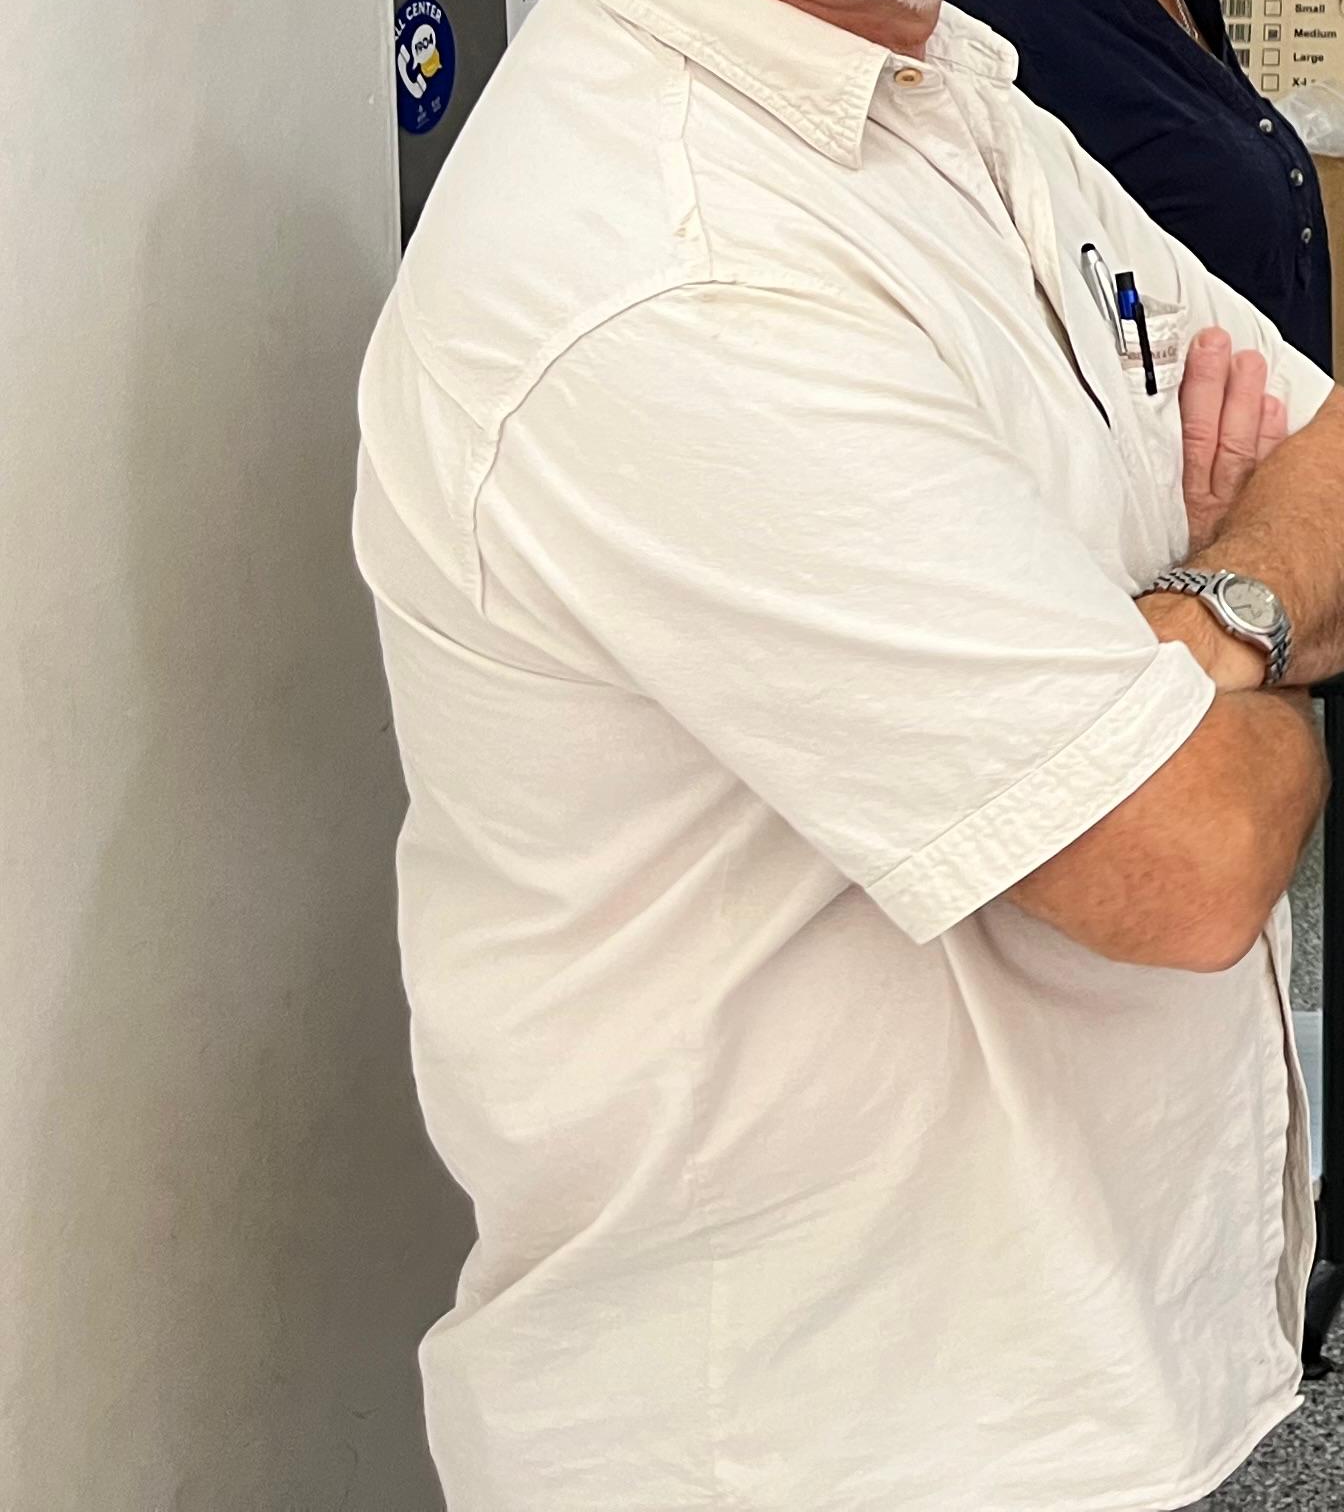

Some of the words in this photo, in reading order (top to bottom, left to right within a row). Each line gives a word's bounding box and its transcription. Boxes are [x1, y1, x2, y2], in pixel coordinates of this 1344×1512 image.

[405, 1, 442, 24] CENTER
[1295, 4, 1325, 13] Small
[1294, 28, 1337, 39] Medium
[1292, 52, 1324, 64] Large
